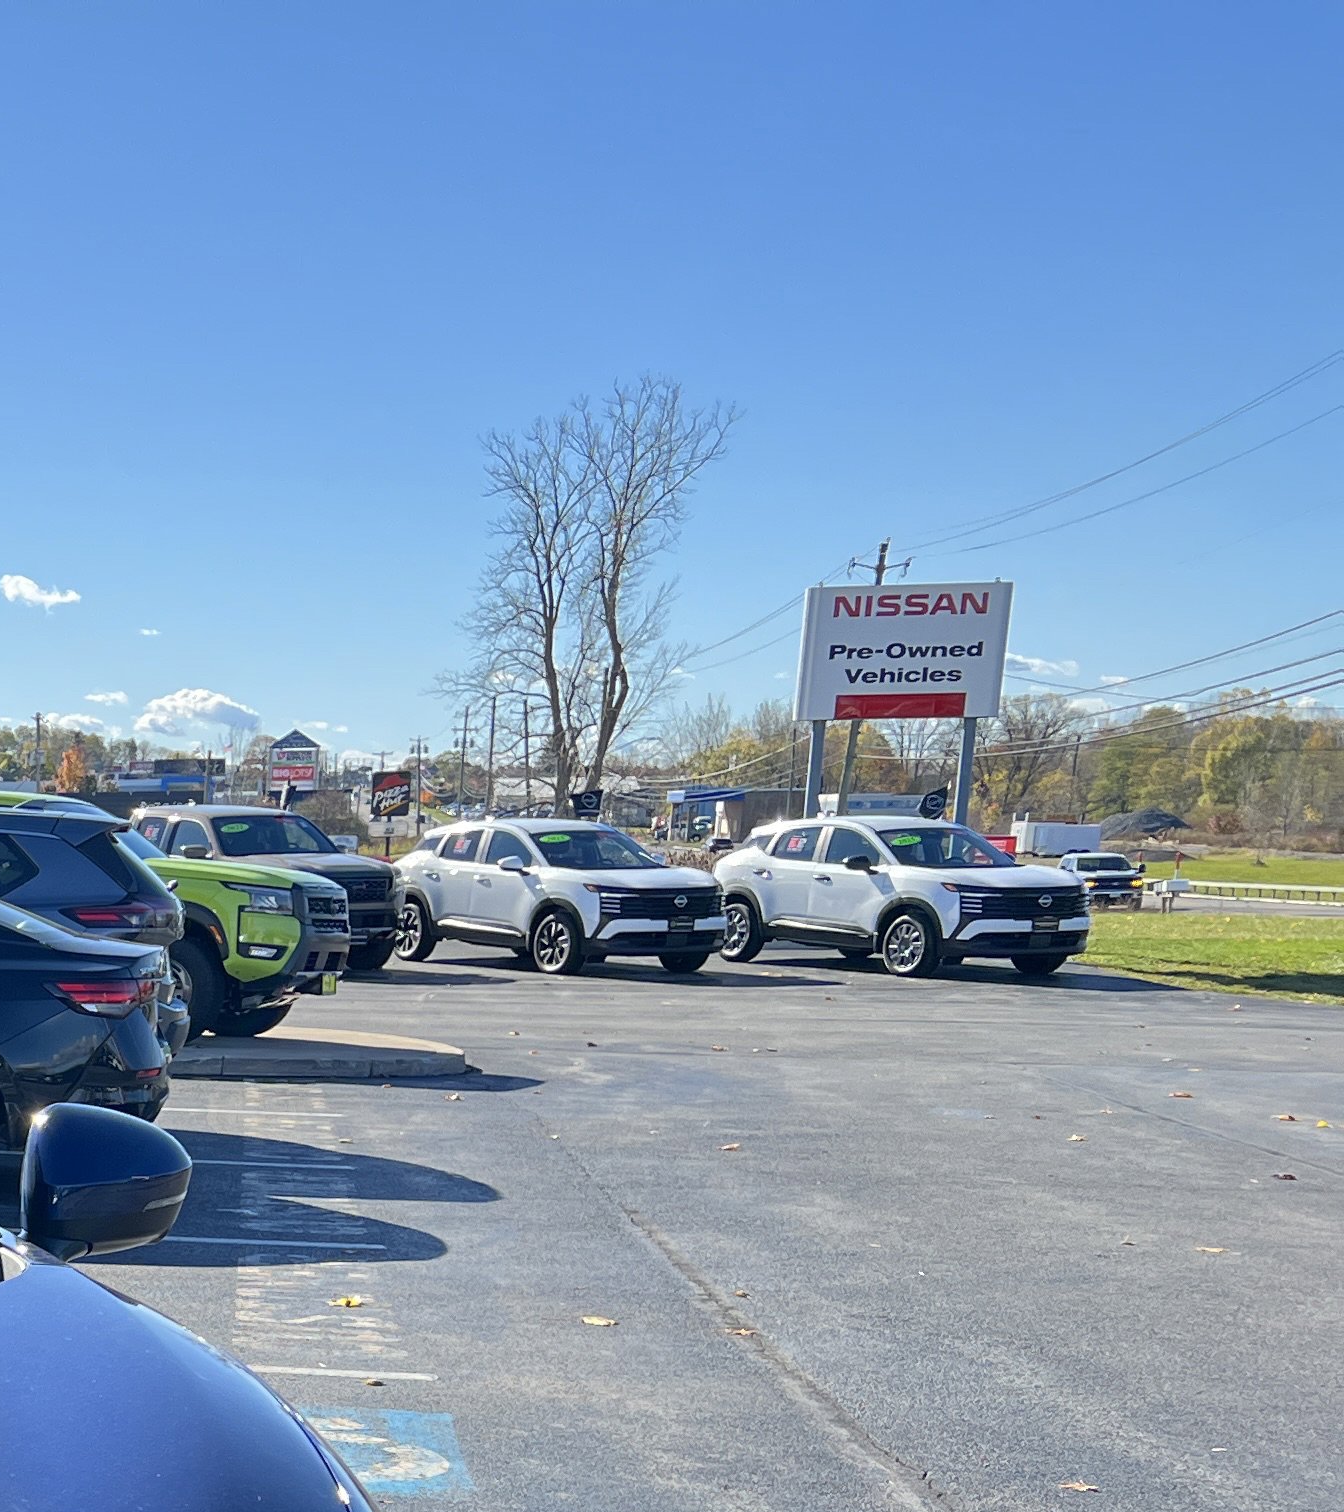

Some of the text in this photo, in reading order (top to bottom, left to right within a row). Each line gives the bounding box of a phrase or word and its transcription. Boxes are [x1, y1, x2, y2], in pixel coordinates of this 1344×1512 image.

[833, 592, 989, 617] NISSAN
[828, 641, 984, 660] Pre-Owned
[845, 667, 963, 684] Vehicles
[372, 784, 410, 808] Pizza
[379, 793, 406, 812] Hut
